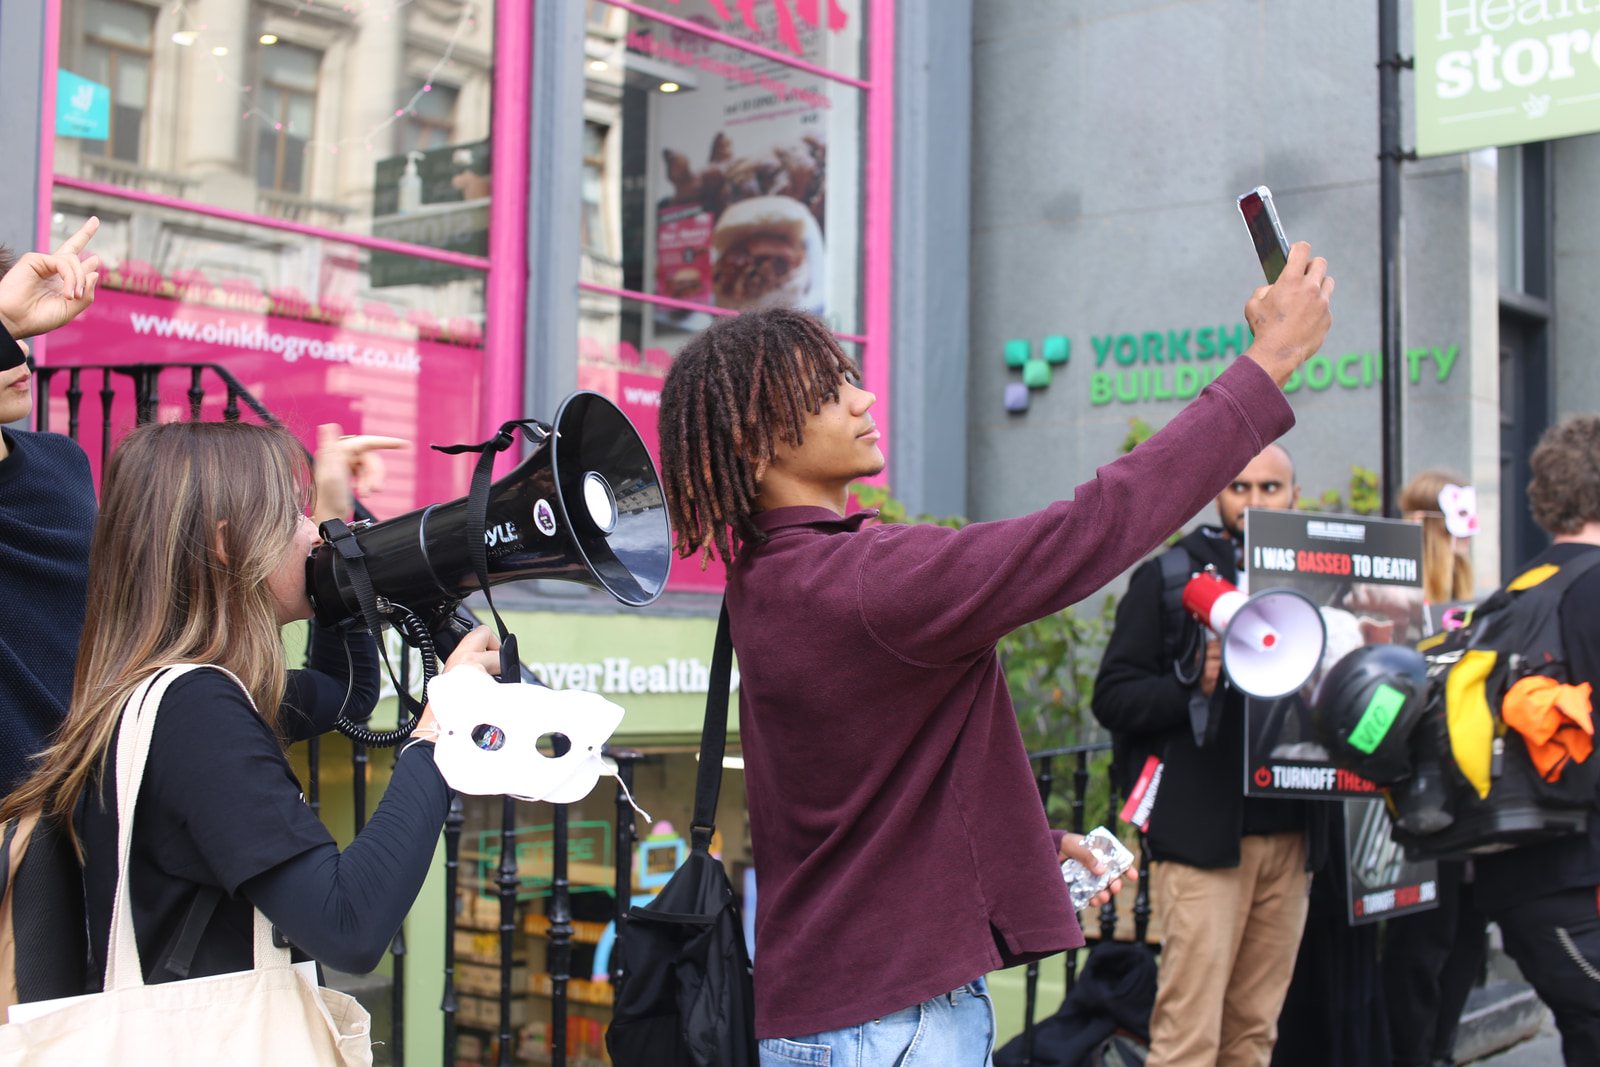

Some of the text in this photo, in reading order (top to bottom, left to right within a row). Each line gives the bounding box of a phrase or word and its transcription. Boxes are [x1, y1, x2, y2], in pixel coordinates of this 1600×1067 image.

[1435, 28, 1600, 99] stor
[130, 312, 422, 373] www.oinkhogroast.co.uk
[1090, 322, 1255, 366] YORKSHI
[1254, 546, 1417, 582] I WAS GASSED TO DEATH
